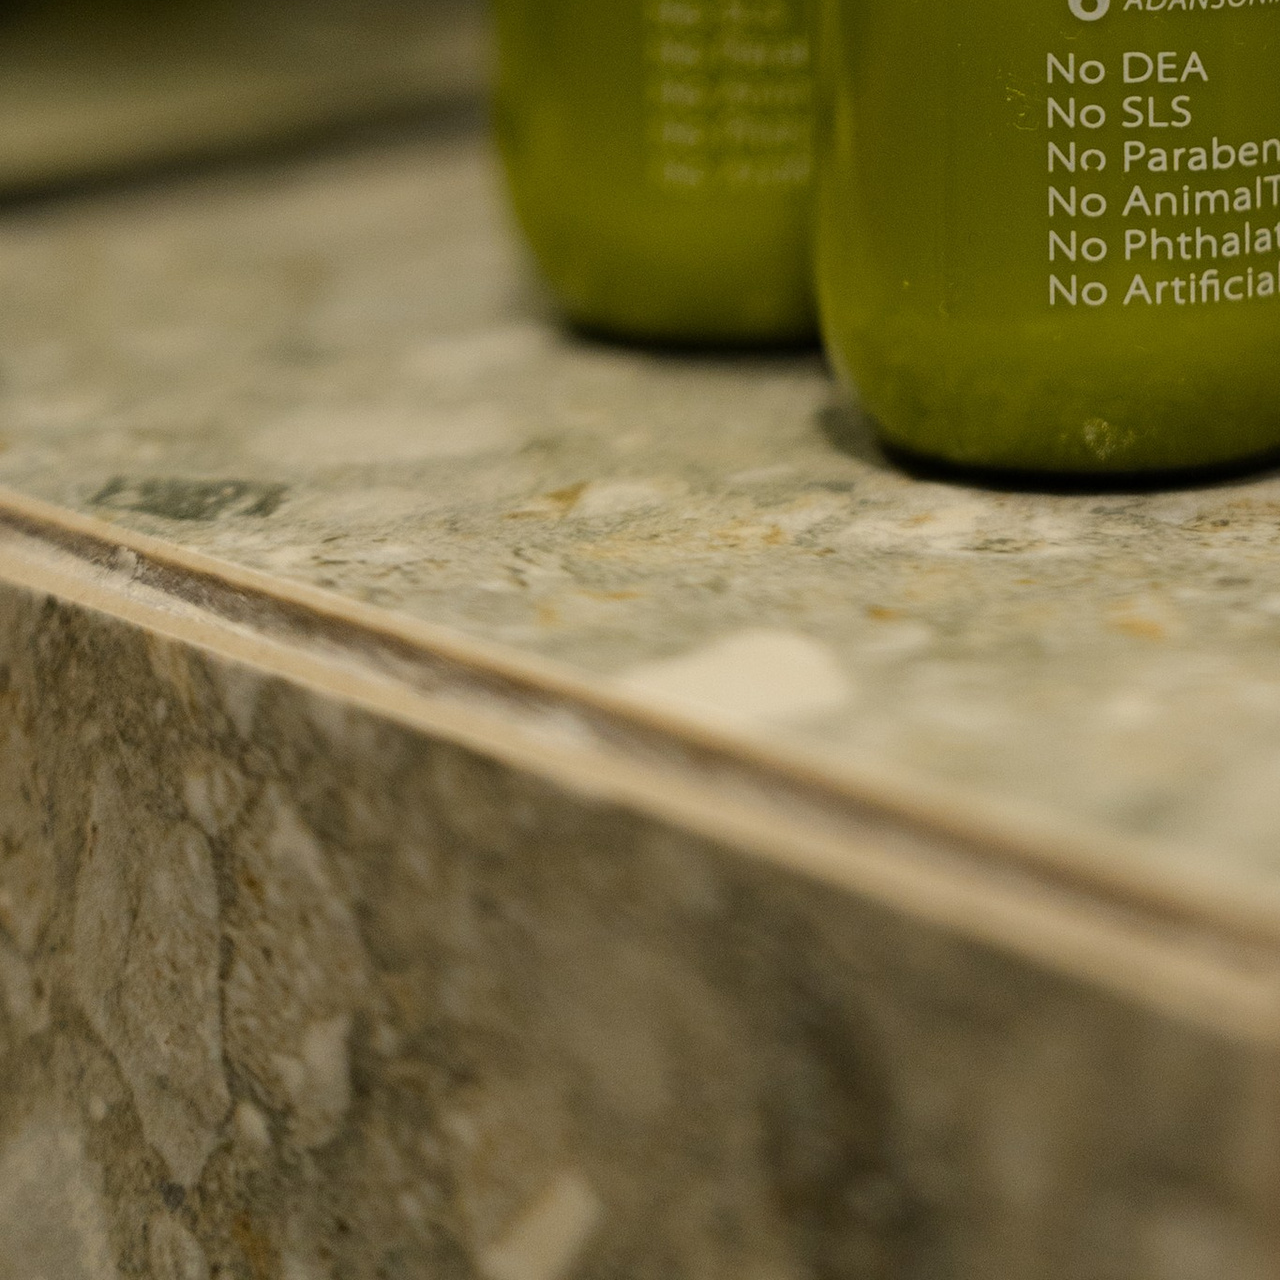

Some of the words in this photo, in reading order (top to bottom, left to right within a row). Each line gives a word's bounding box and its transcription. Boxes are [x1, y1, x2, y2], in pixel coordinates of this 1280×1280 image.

[1046, 51, 1107, 85] No
[1122, 50, 1209, 84] DEA
[1046, 96, 1107, 129] No
[1121, 95, 1192, 129] SLS
[1047, 141, 1107, 173] No
[1047, 185, 1108, 218] No
[1048, 230, 1108, 262] No
[1048, 274, 1108, 307] No
